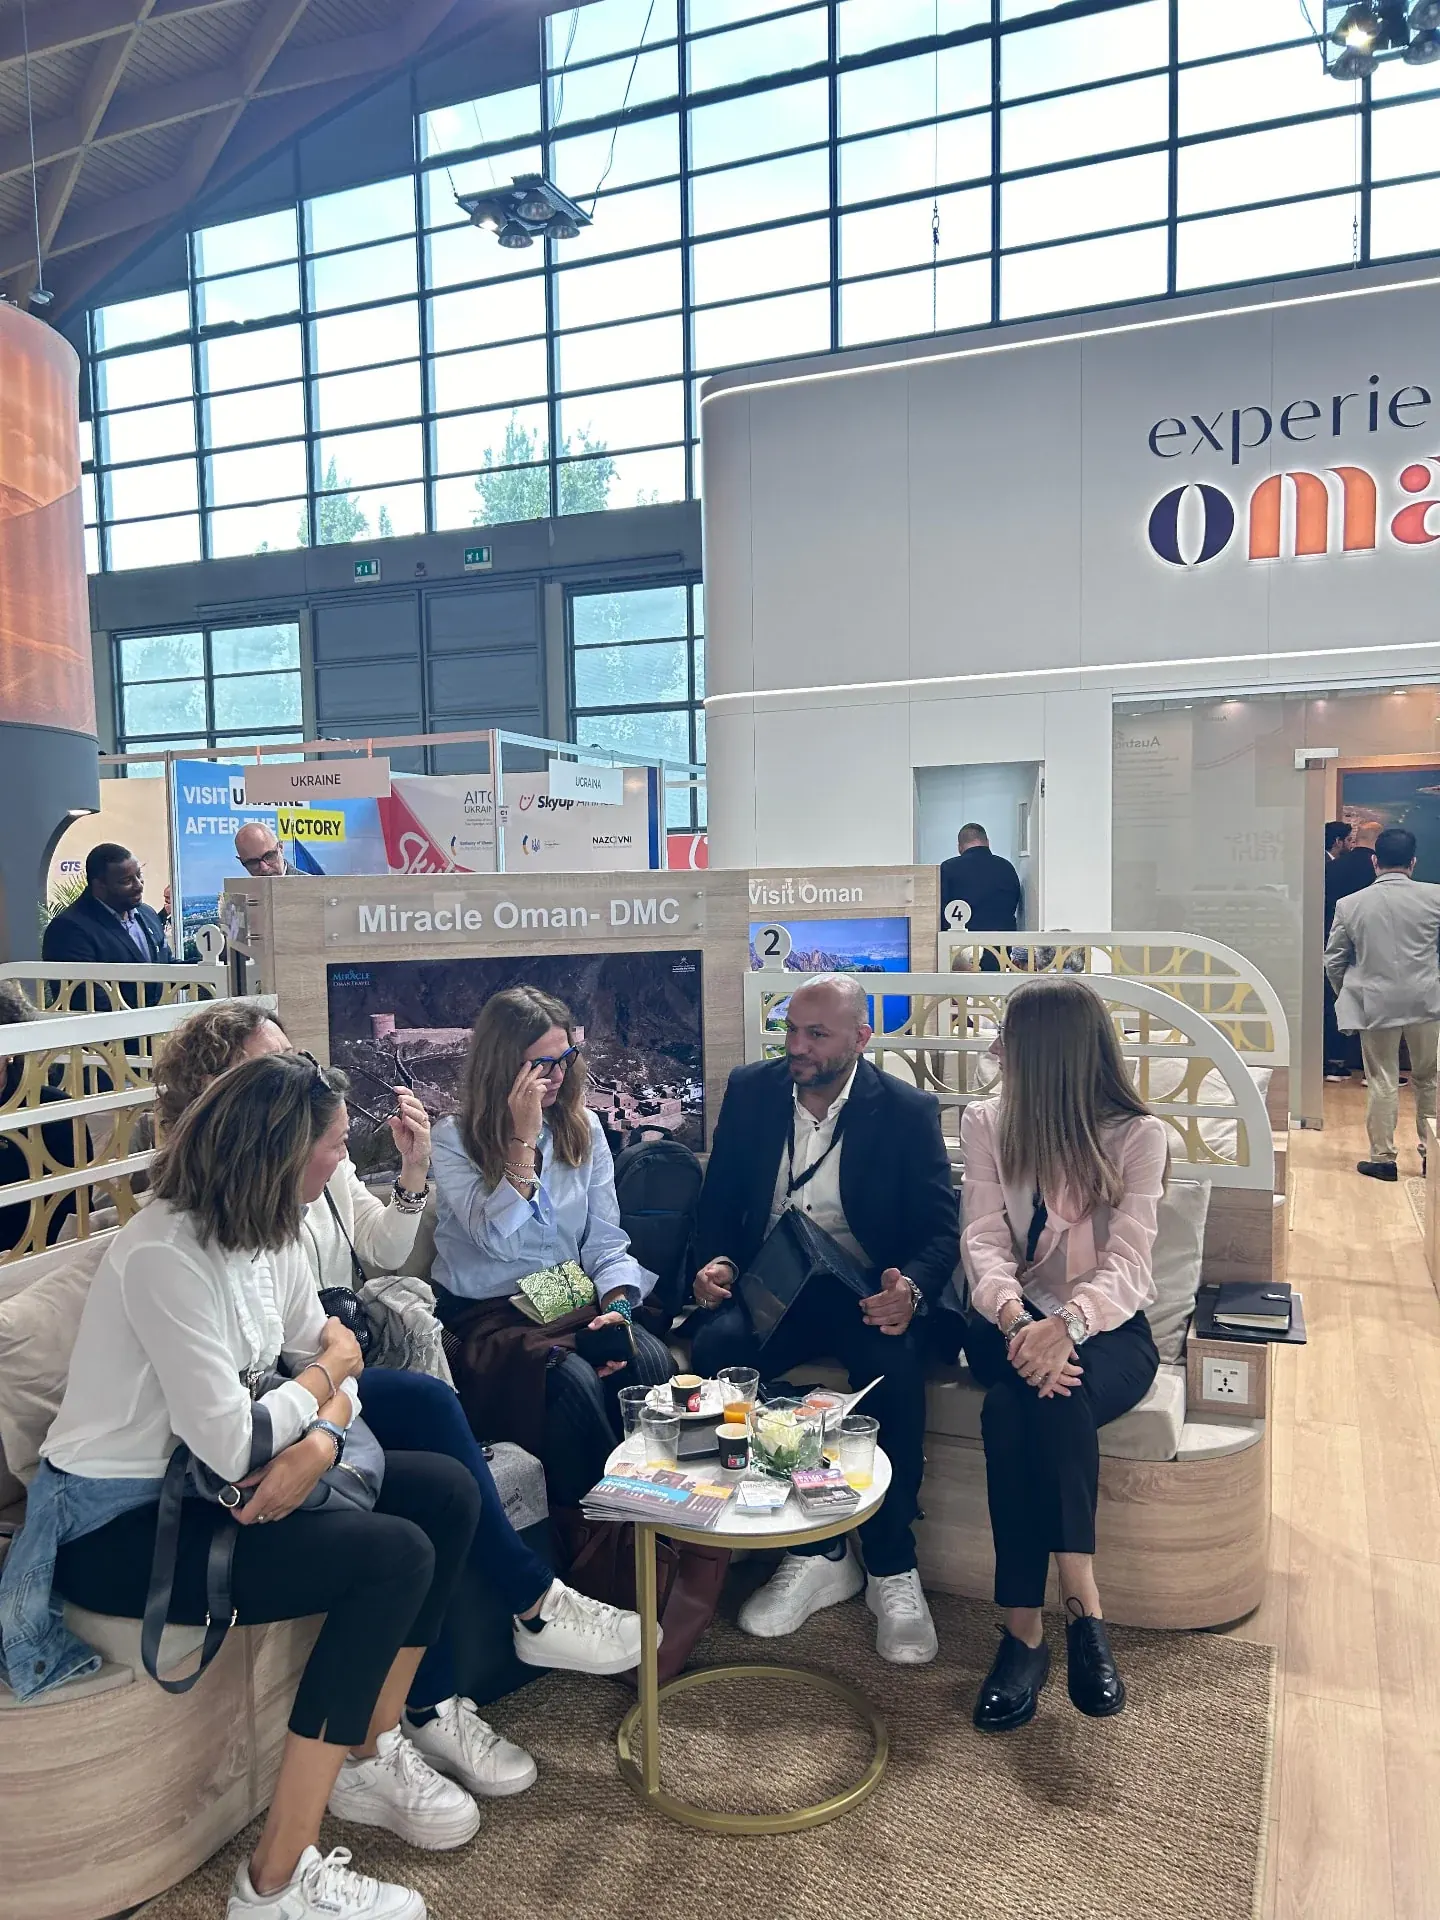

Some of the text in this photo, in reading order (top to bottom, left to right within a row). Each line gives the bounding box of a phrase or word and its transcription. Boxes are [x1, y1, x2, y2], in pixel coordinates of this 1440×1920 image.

[1148, 374, 1432, 465] experie
[291, 773, 341, 787] UKRAINE
[575, 775, 602, 790] UCRAINA
[183, 786, 228, 805] VISIT
[185, 817, 239, 835] AFTER
[60, 861, 82, 872] GTS
[749, 883, 863, 905] Visit Oman
[358, 898, 681, 933] Miracle Oman- DMC
[951, 905, 964, 921] 4
[202, 930, 212, 952] 1
[764, 929, 781, 956] 2
